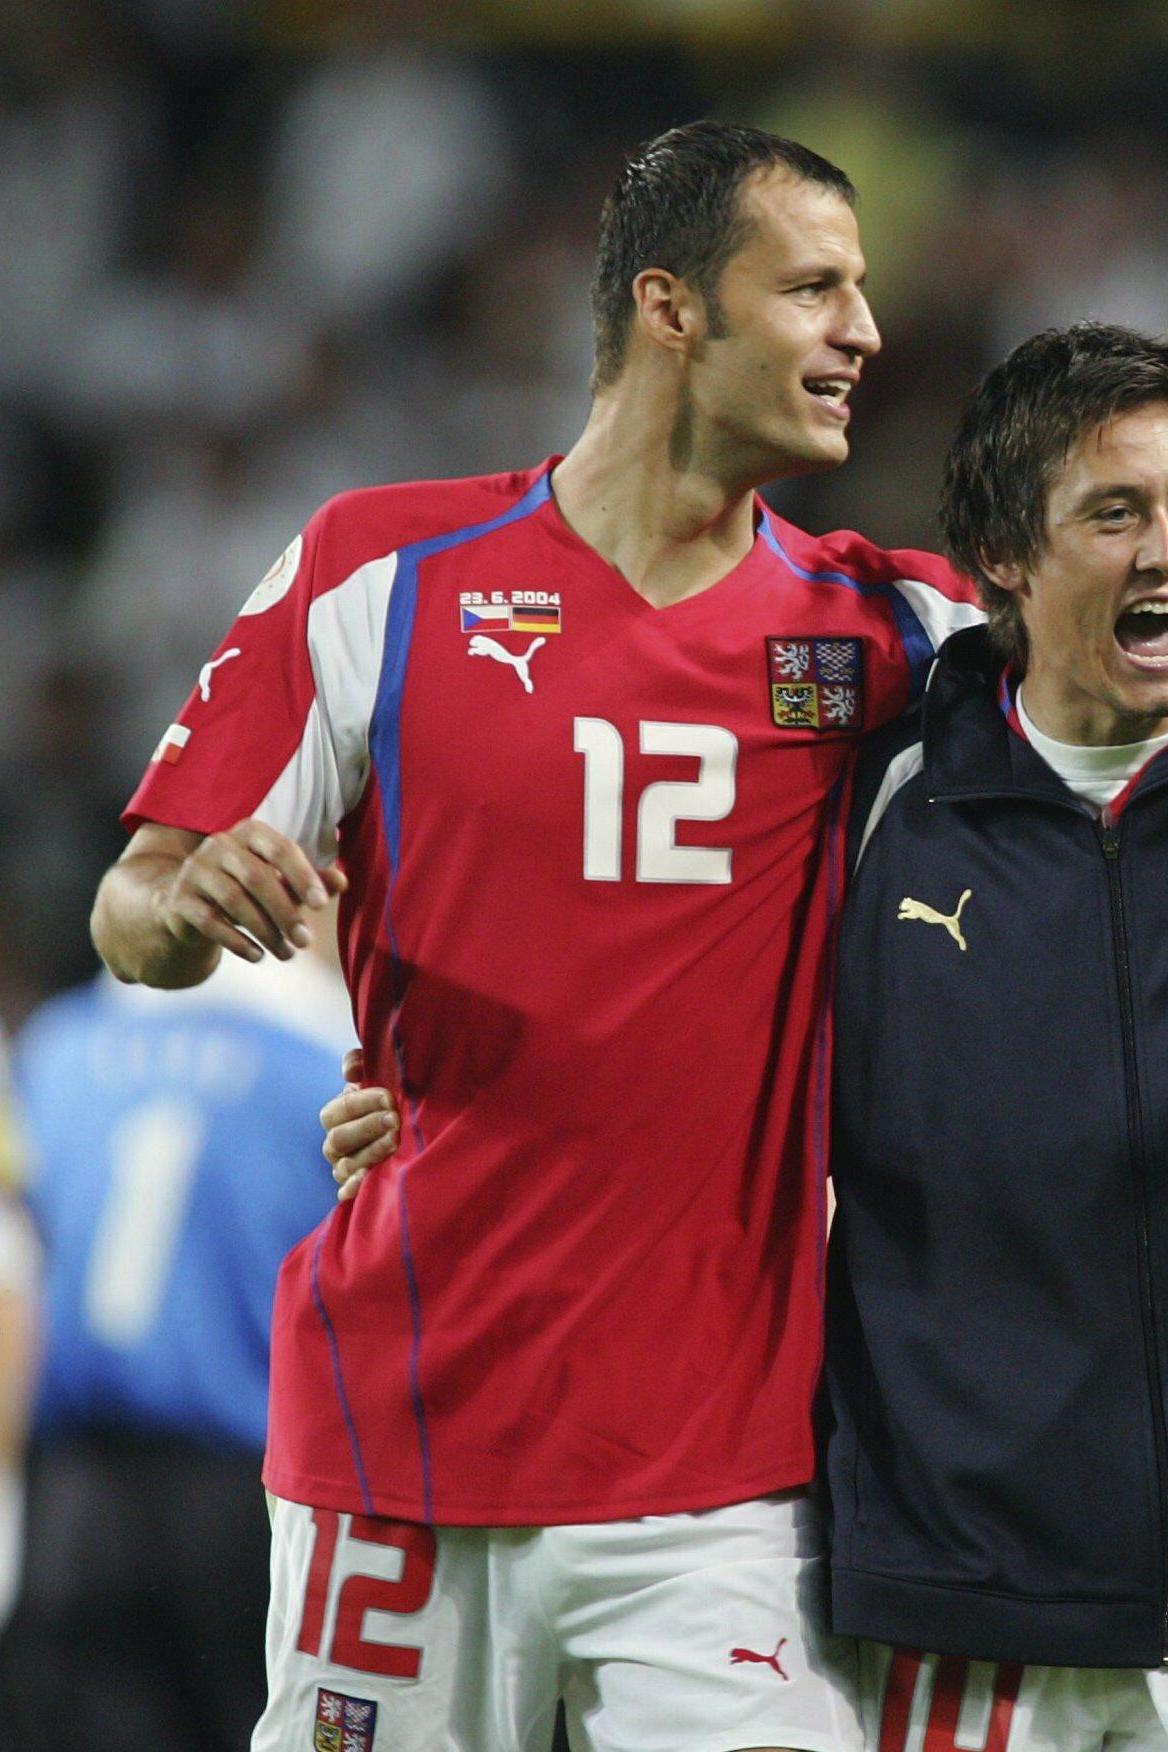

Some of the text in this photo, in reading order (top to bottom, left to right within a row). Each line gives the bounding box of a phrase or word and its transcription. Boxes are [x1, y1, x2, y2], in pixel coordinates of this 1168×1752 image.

[573, 716, 739, 885] 12
[88, 1102, 202, 1342] 1
[295, 1507, 438, 1680] 12
